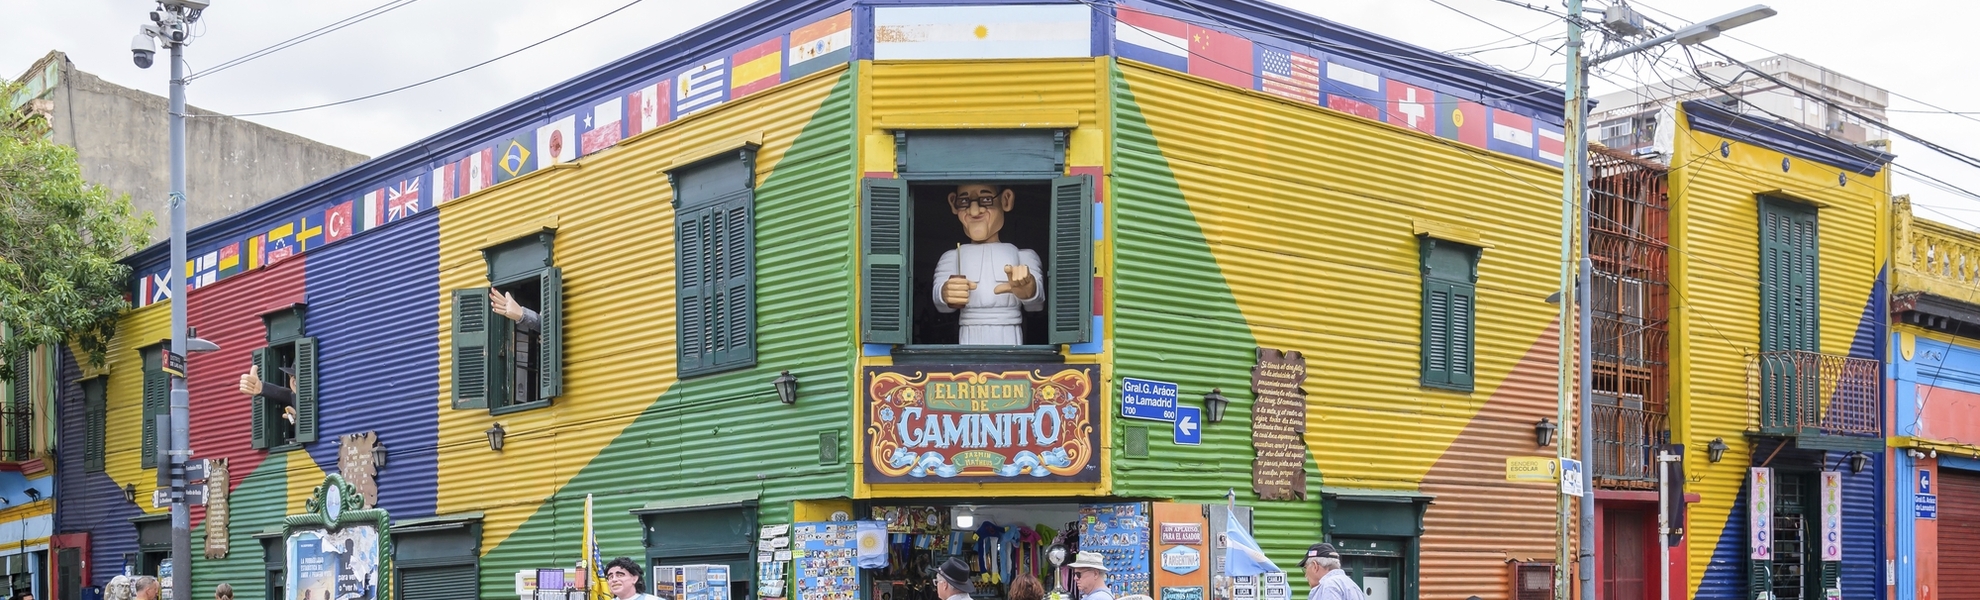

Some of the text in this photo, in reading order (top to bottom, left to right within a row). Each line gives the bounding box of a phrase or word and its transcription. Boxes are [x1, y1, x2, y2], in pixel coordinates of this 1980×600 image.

[935, 382, 1024, 400] EL RINCON
[1153, 385, 1175, 397] Aráoz
[971, 400, 989, 411] DE
[1125, 394, 1172, 408] de Lamadrid
[896, 404, 1062, 448] CAMINITO
[1756, 472, 1767, 557] KIOSCO
[1826, 476, 1837, 557] KIOSCO
[1168, 555, 1195, 565] ARGENTINA
